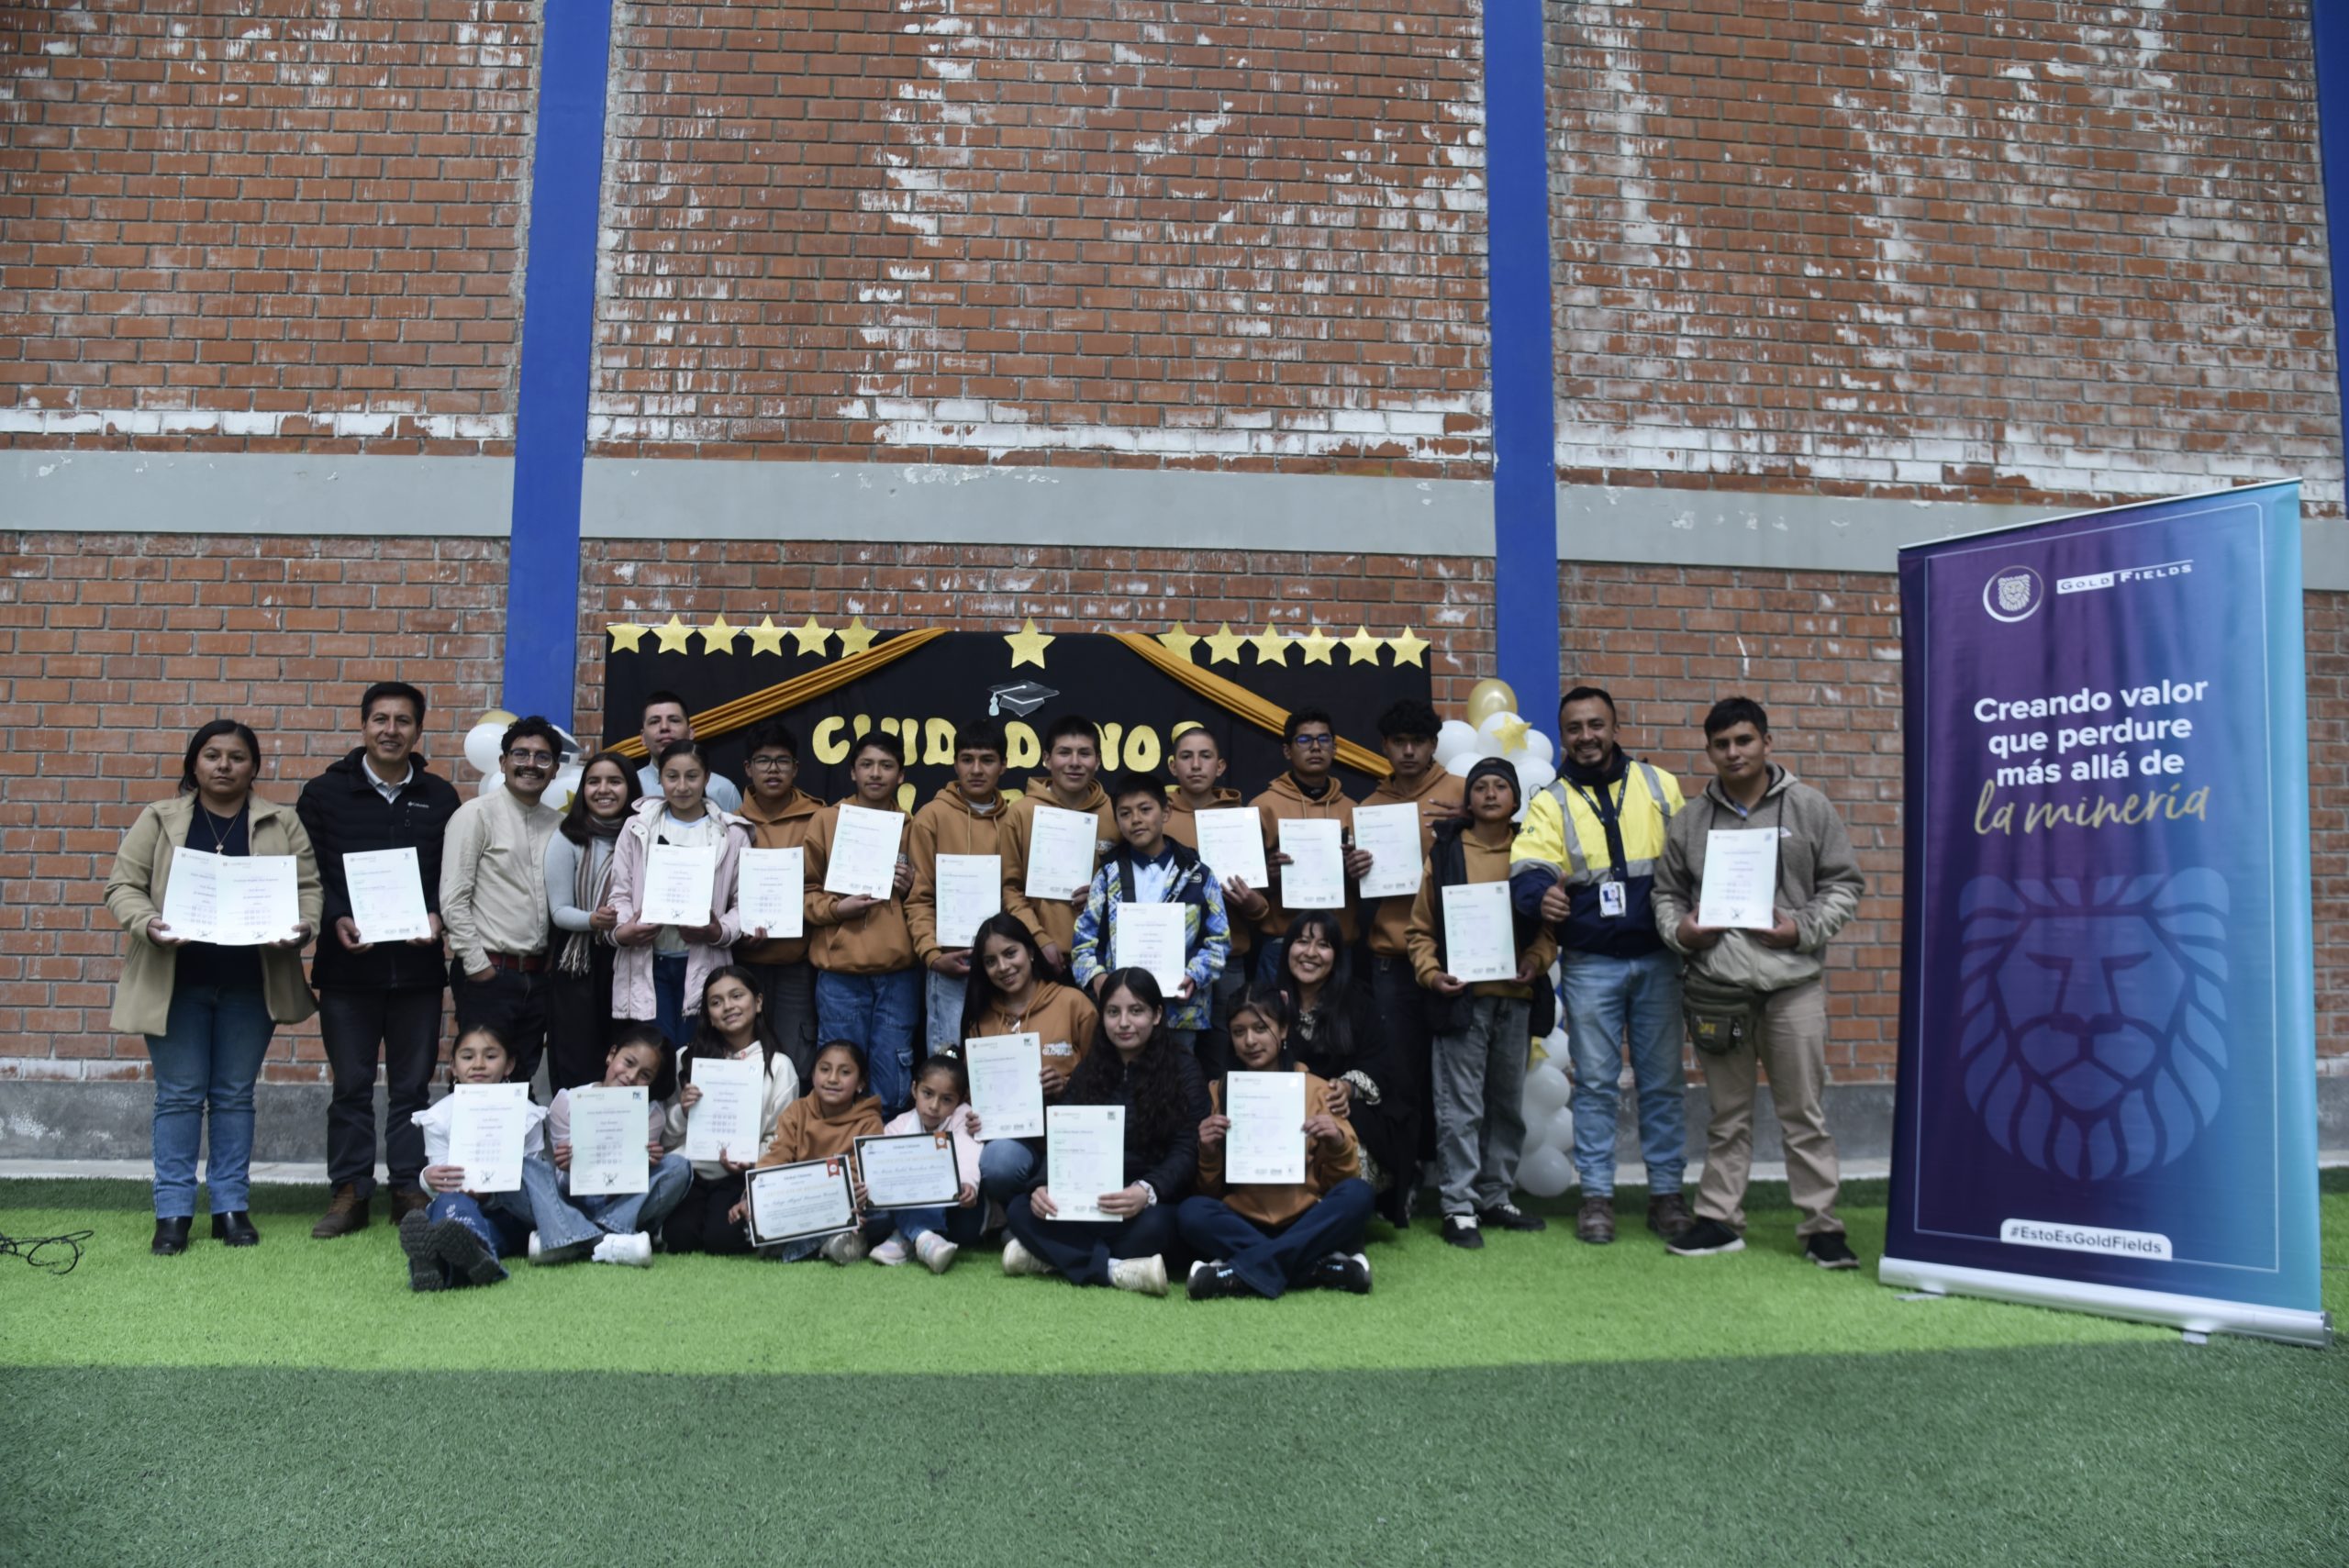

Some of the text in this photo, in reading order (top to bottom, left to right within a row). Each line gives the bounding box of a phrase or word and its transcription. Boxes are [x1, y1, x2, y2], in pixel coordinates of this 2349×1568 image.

[2061, 564, 2192, 591] GOLD FIELDS
[1973, 679, 2209, 723] Creando valor
[1988, 717, 2193, 759] que perdure
[1996, 750, 2185, 786] más allá de
[1974, 779, 2210, 836] la minería
[2009, 1226, 2162, 1253] #EstoEsGoldFields
